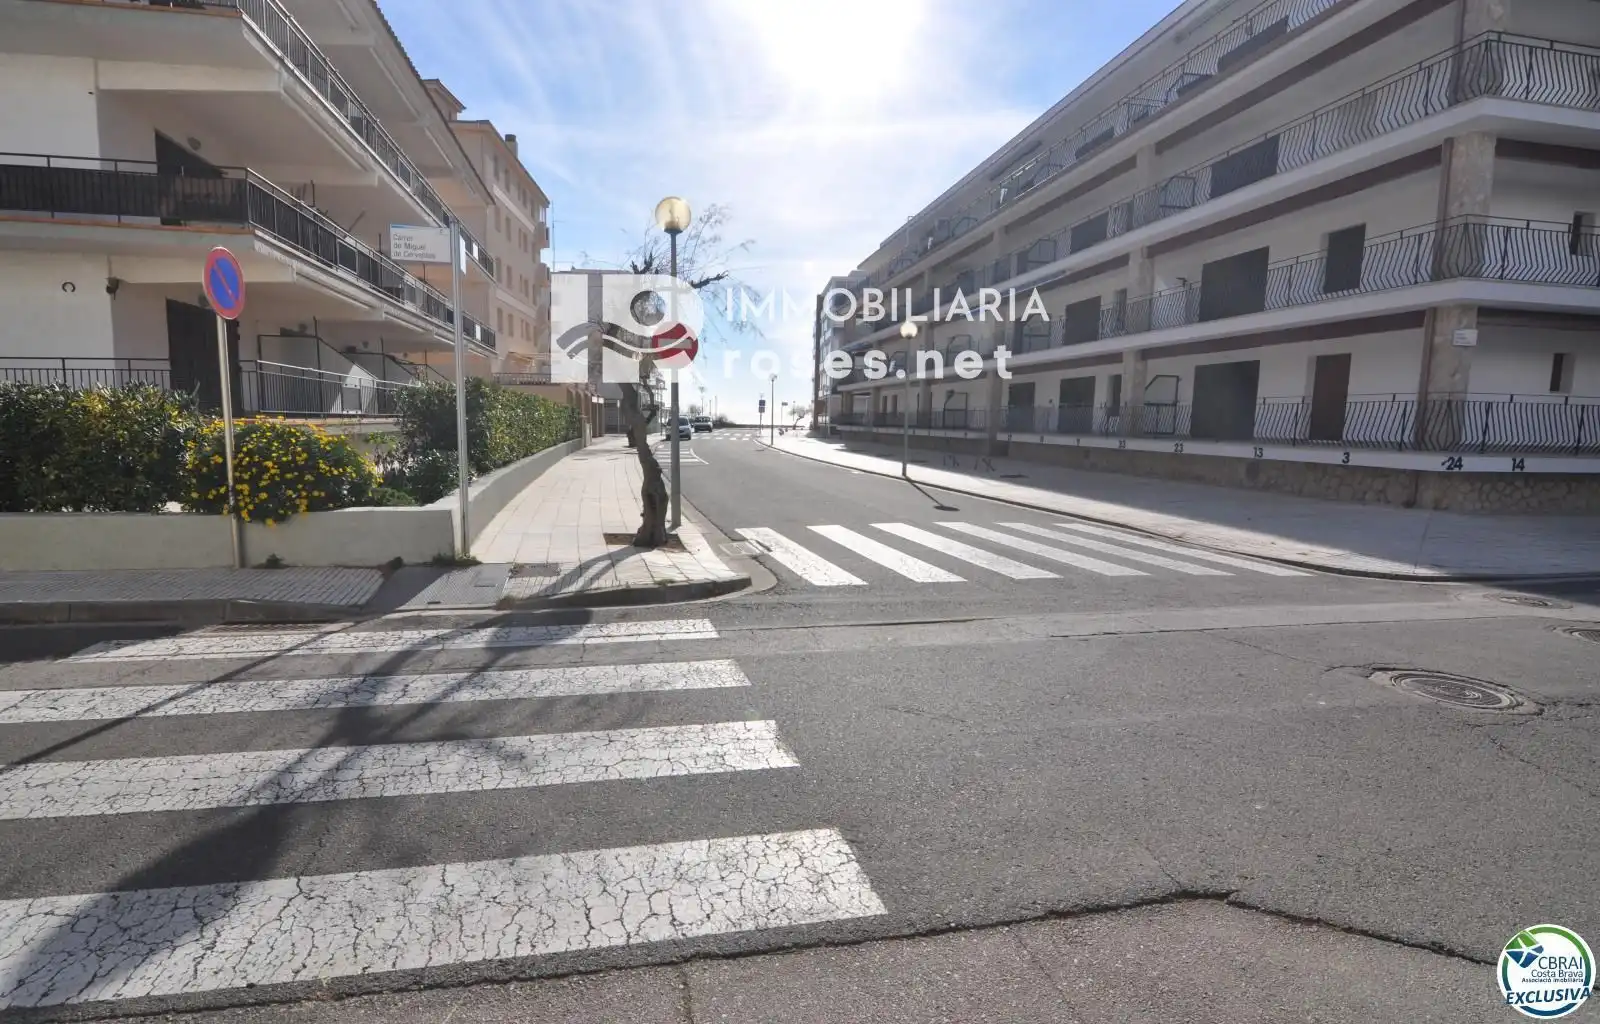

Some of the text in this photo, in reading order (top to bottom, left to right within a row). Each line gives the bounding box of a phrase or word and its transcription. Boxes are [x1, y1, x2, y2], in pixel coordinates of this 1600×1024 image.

[1253, 447, 1263, 458] 13
[1342, 452, 1350, 464] 3
[1511, 458, 1525, 471] 14
